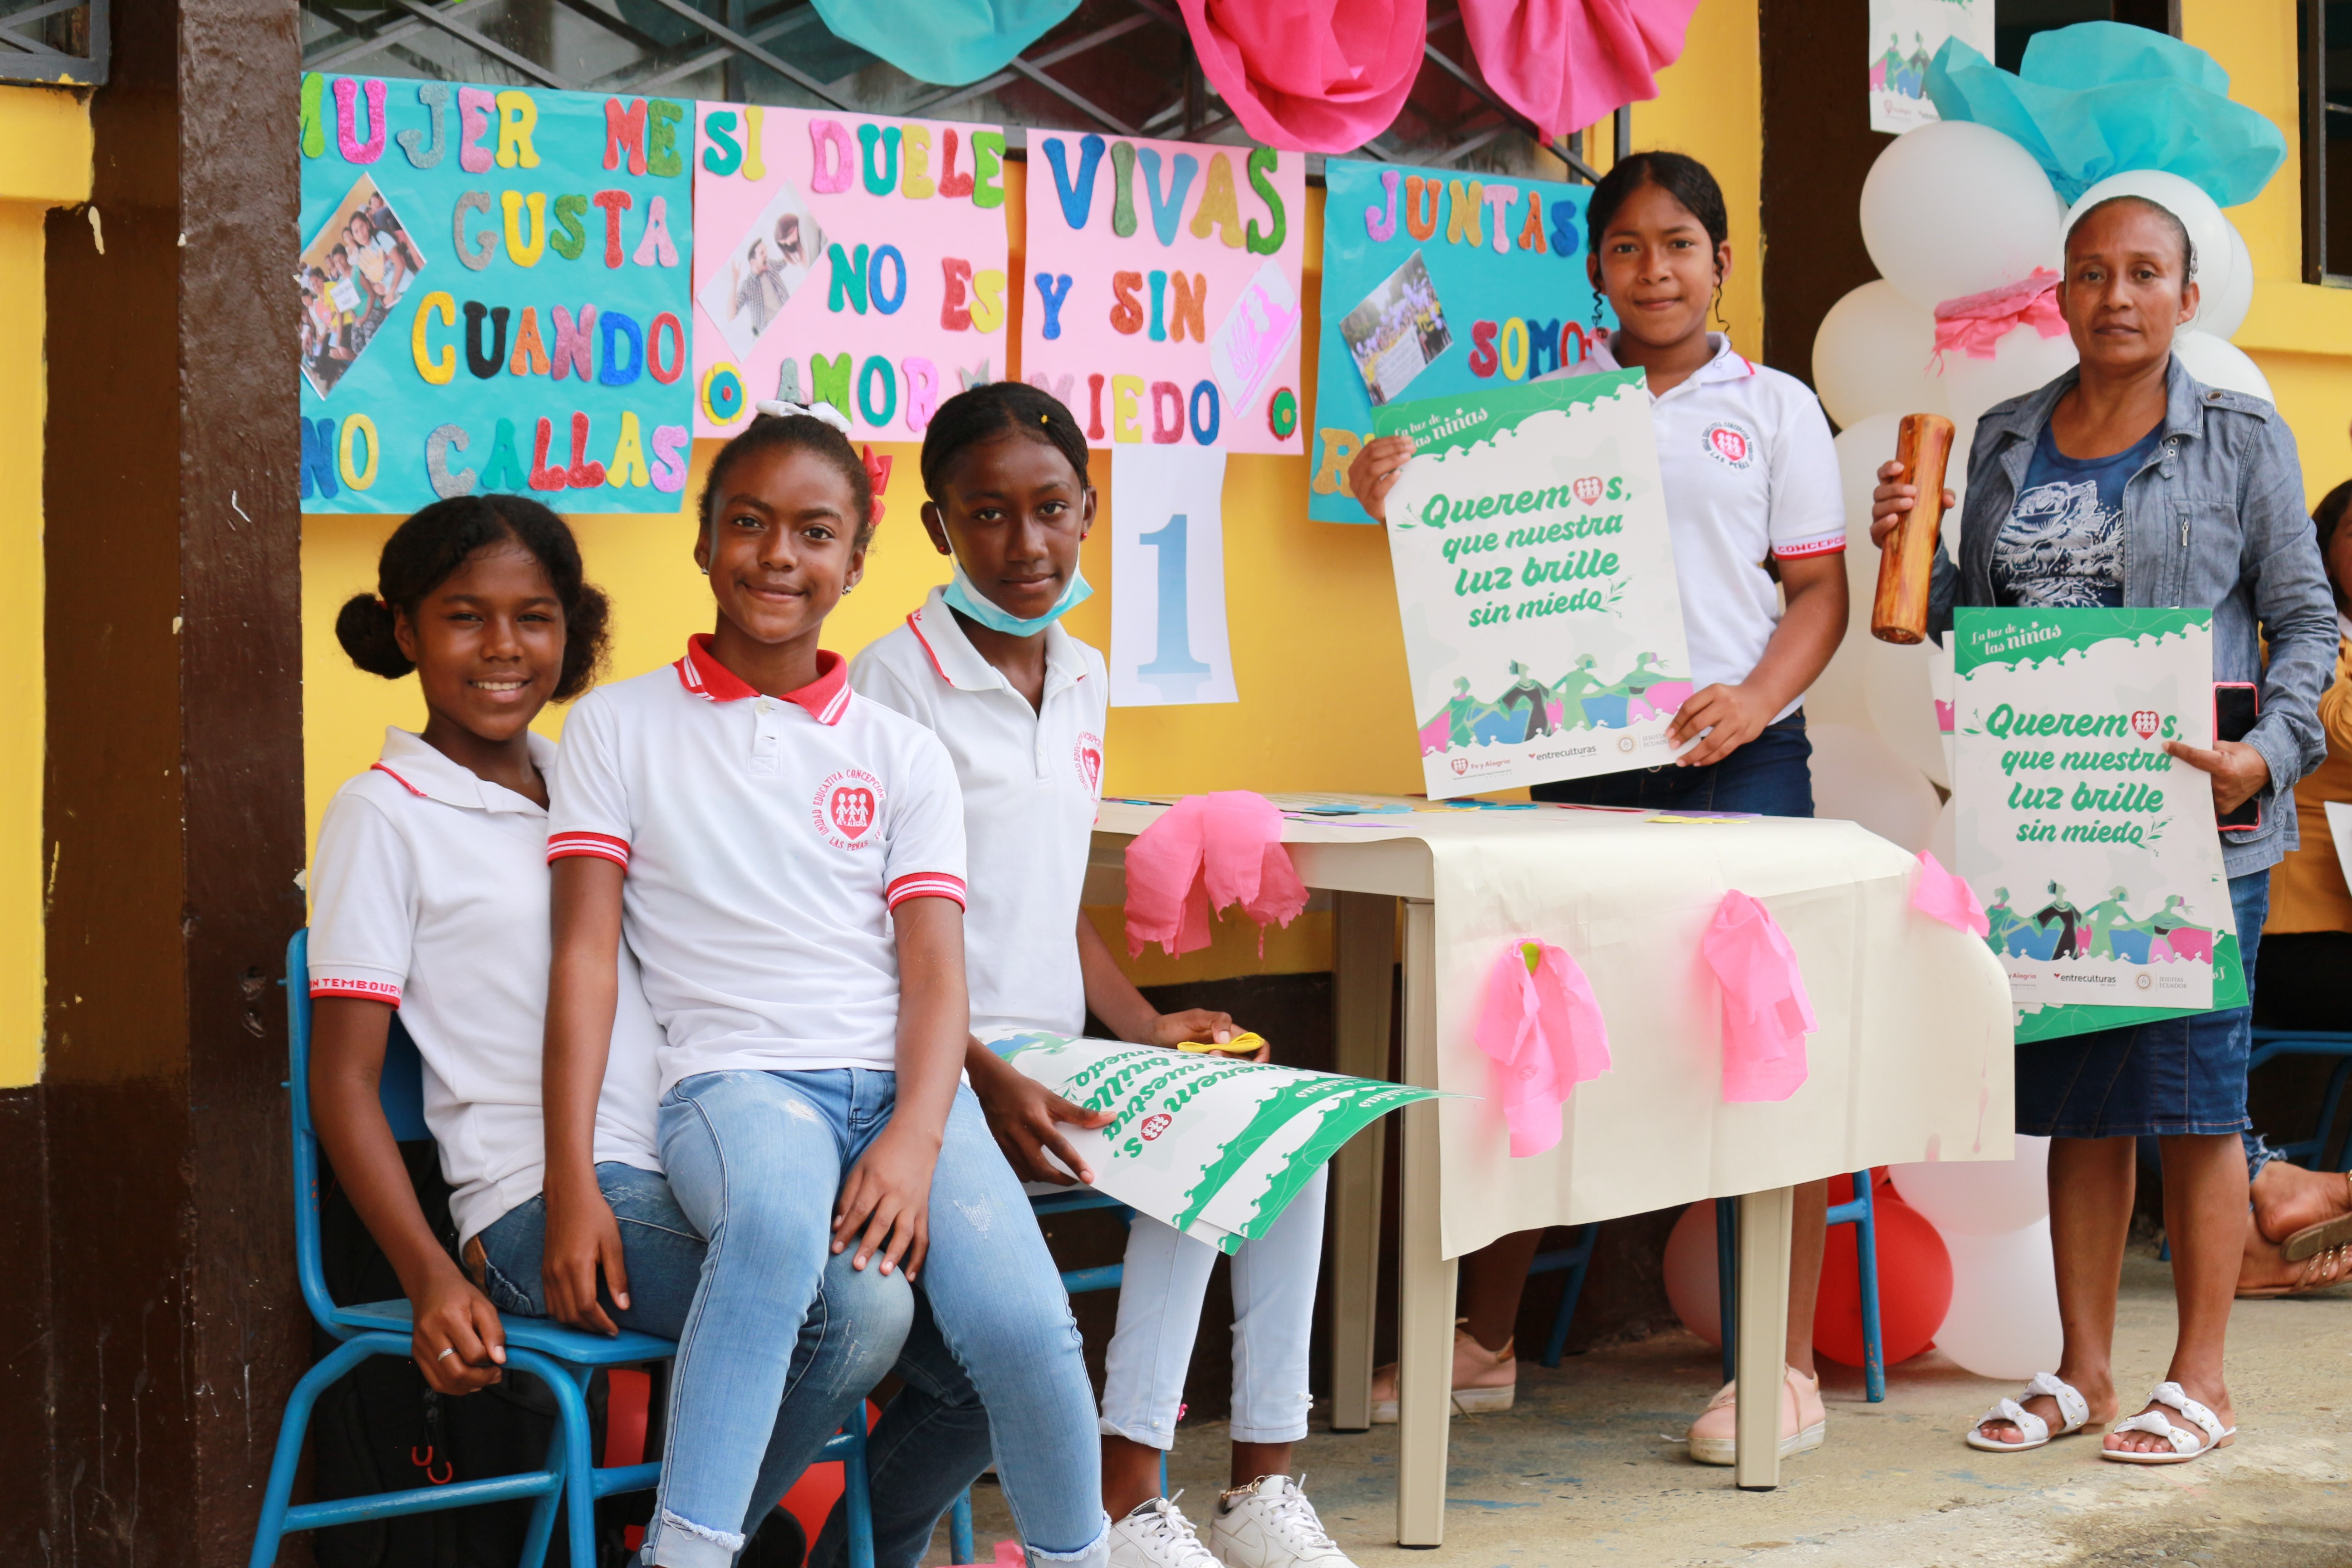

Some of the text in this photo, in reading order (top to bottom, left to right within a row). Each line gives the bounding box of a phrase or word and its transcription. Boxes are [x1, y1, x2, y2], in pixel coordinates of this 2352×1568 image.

[603, 98, 683, 177] ME
[704, 105, 1006, 208] SI DUELE
[1042, 134, 1286, 255] VIVAS
[1365, 170, 1578, 257] JUNTAS
[454, 189, 678, 270] GUSTA
[828, 243, 1005, 333] NO ES
[1035, 270, 1206, 343] Y SIN
[412, 291, 684, 385] CUANDO
[1469, 317, 1608, 381] SOMO
[776, 353, 938, 432] AMOR
[1410, 421, 1426, 433] luz
[1429, 414, 1441, 425] de
[1412, 436, 1431, 448] as
[301, 411, 688, 500] NO CALLAS
[1442, 514, 1623, 564] que nuestra
[1455, 549, 1619, 596] luz brille
[1138, 514, 1212, 675] 1
[1469, 588, 1602, 627] sin miedo
[1970, 623, 2017, 645] La luz de
[1985, 642, 2004, 655] las
[1537, 745, 1596, 760] entreculturas
[1644, 739, 1670, 747] ECUADO
[2001, 747, 2173, 776] que nuestra
[813, 771, 843, 806] EDUCATIVA
[2008, 781, 2164, 813] luz brille
[812, 809, 829, 836] UNIDAD
[829, 836, 844, 848] LAS
[2016, 818, 2144, 843] sin miedo
[322, 979, 402, 996] TEMBOURY
[2061, 973, 2116, 983] entreculturas
[1076, 1050, 1154, 1087] miedo
[1103, 1063, 1205, 1142] nuestra
